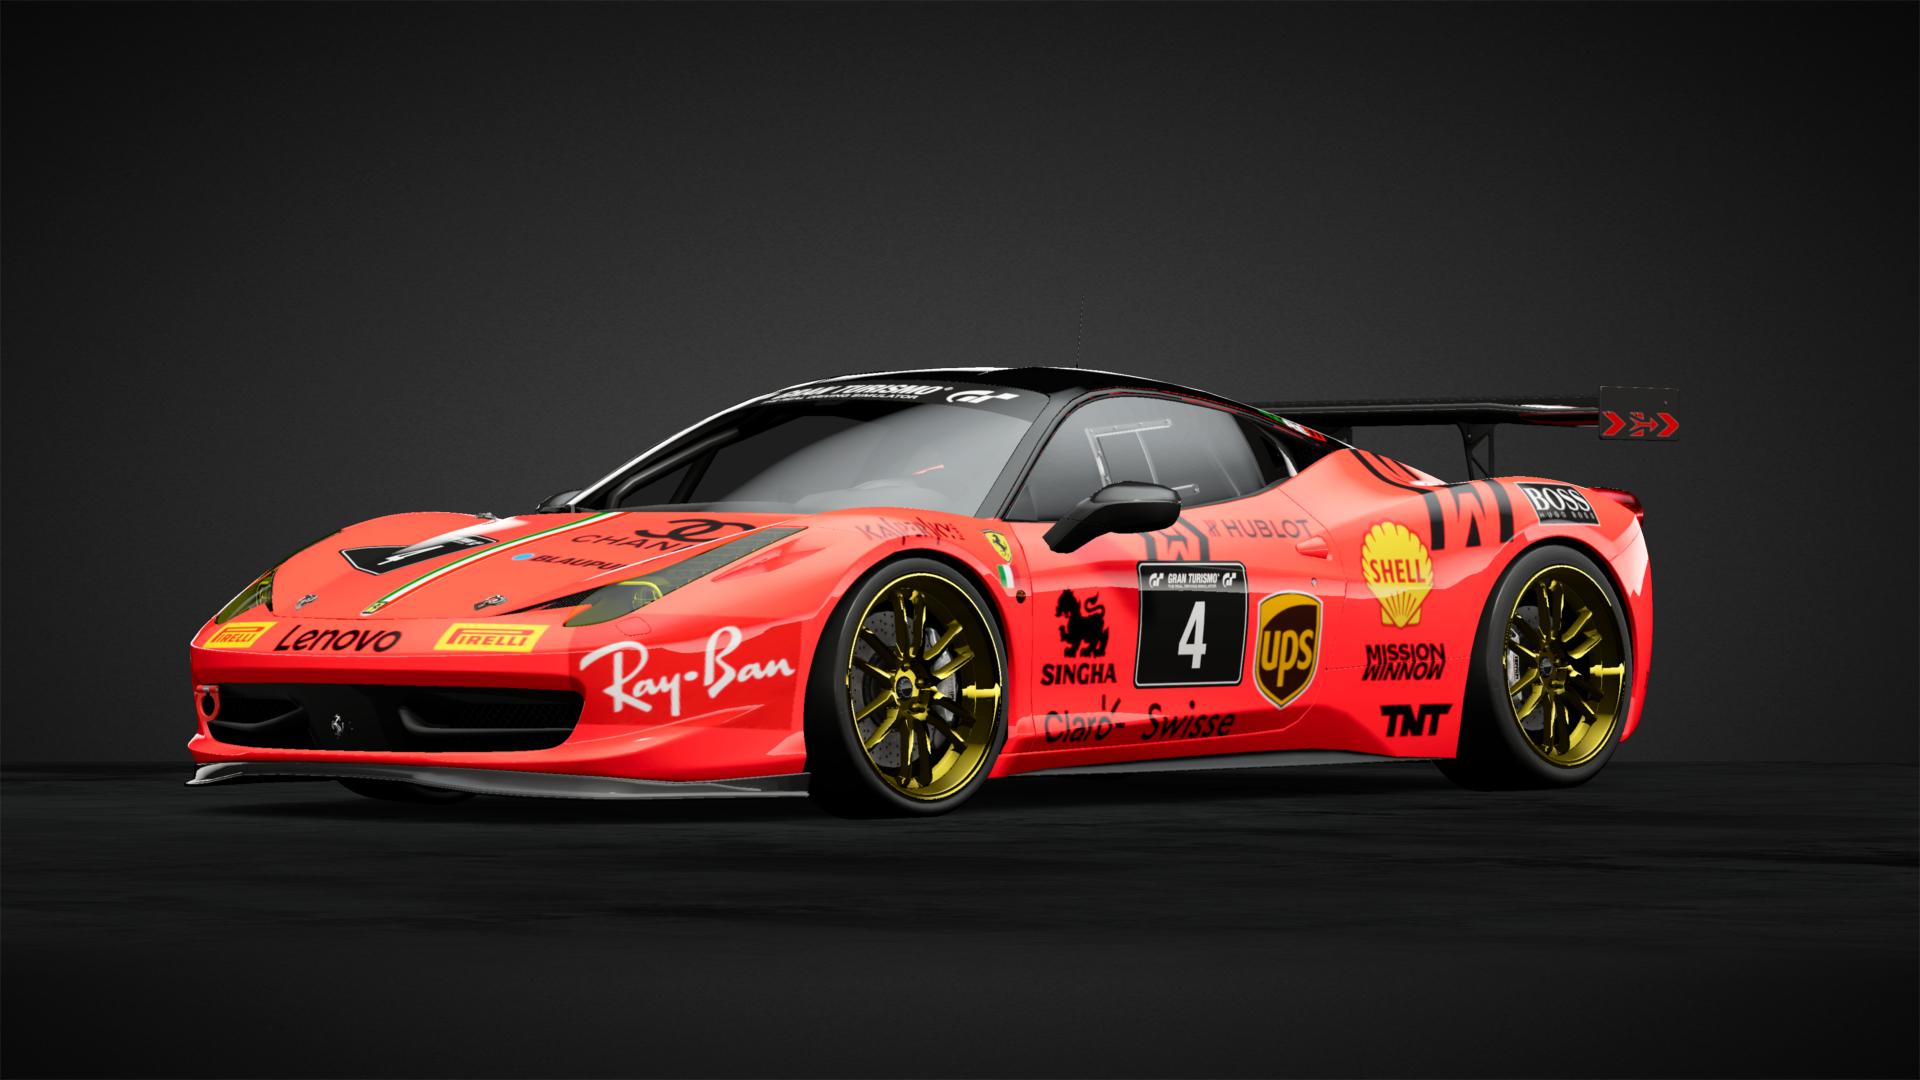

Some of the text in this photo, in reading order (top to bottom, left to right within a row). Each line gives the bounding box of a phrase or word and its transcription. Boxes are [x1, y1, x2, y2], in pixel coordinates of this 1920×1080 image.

[1523, 487, 1591, 512] BOSS
[1220, 519, 1310, 539] HUBLOT
[1167, 573, 1220, 584] GRAN TURISMO
[1370, 559, 1427, 584] SHELL
[210, 626, 266, 643] PIRELLI
[273, 624, 402, 652] Lenovo
[446, 628, 535, 646] PIRELLI
[1177, 601, 1207, 669] 4
[1261, 629, 1314, 688] ups
[1365, 643, 1445, 664] MISSION
[579, 626, 796, 717] Ray-Ban
[1040, 663, 1117, 686] SINGHA
[1361, 661, 1446, 681] WINNOW
[1141, 700, 1235, 740] Swisse
[1380, 703, 1453, 737] TNT
